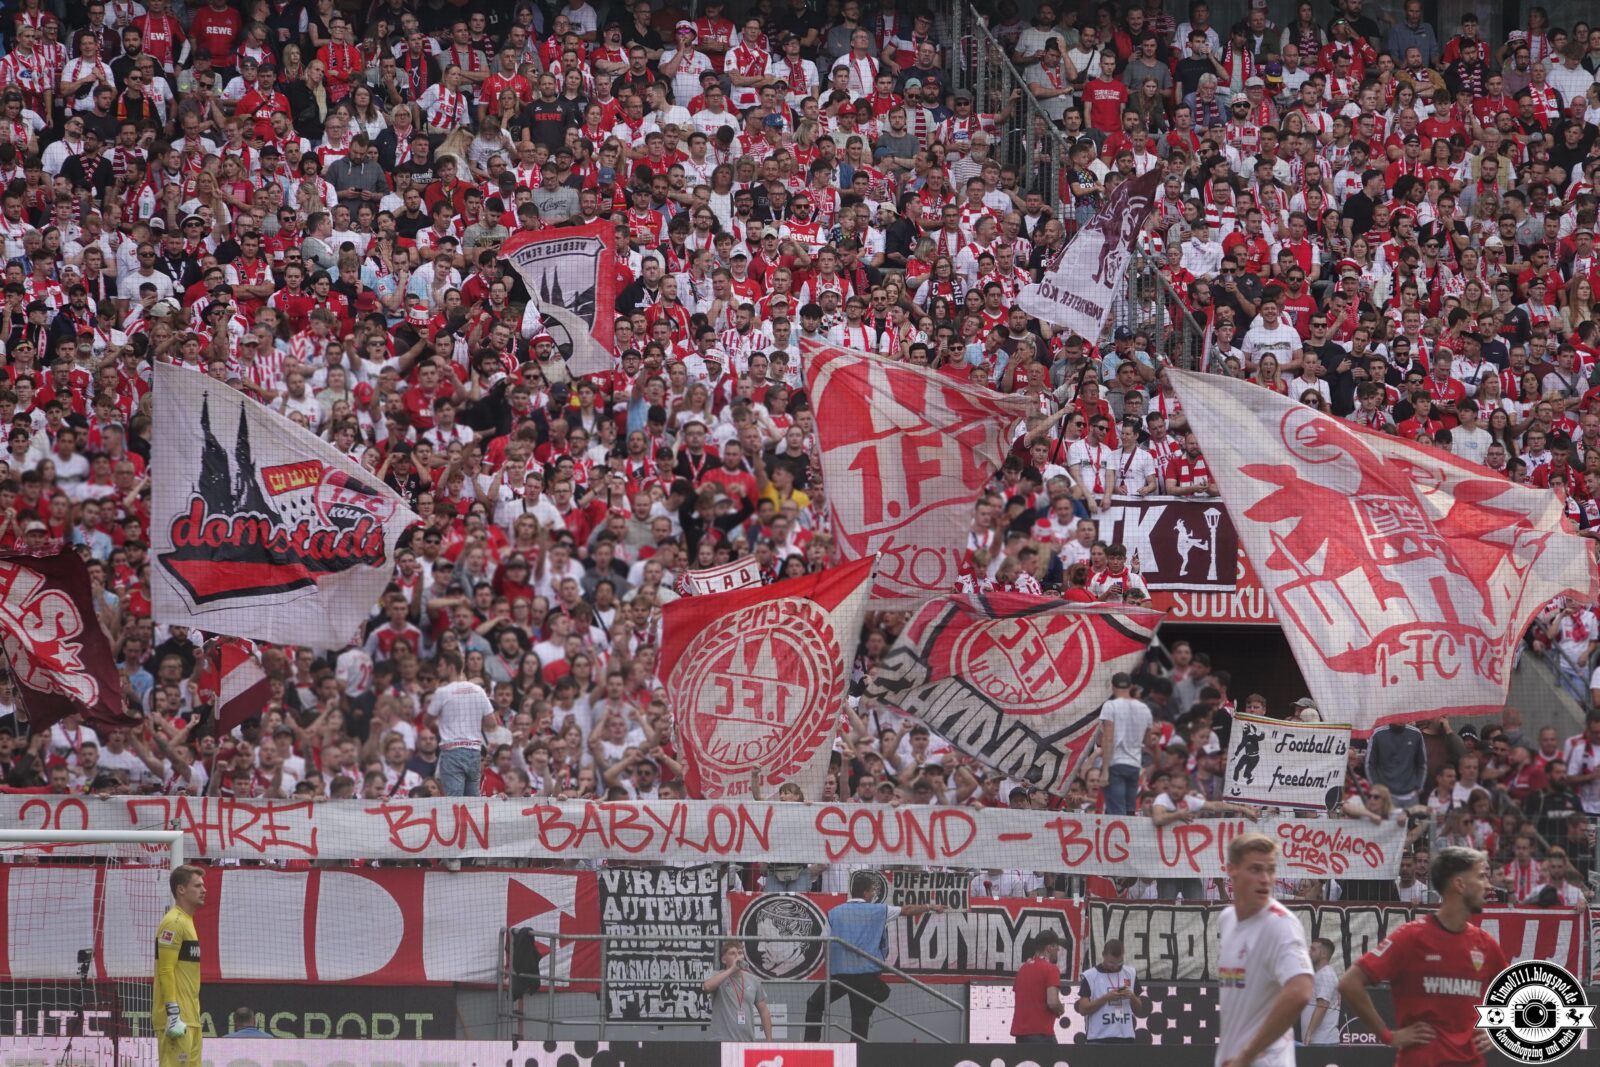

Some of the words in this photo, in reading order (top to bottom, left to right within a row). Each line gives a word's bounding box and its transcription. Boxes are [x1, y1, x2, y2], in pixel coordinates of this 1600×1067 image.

[206, 26, 233, 36] REWE
[535, 113, 562, 121] REWE
[790, 233, 816, 243] REWE
[1335, 740, 1346, 755] is
[127, 796, 318, 857] JAHRE
[366, 803, 489, 853] BUN
[523, 803, 773, 853] BABYLON
[815, 807, 977, 861] SOUND
[600, 868, 718, 895] VIRAGE
[893, 872, 968, 889] DIFFIDATI
[934, 890, 967, 909] NOI
[603, 896, 718, 921] AUTEUIL
[1102, 1012, 1131, 1025] SMF
